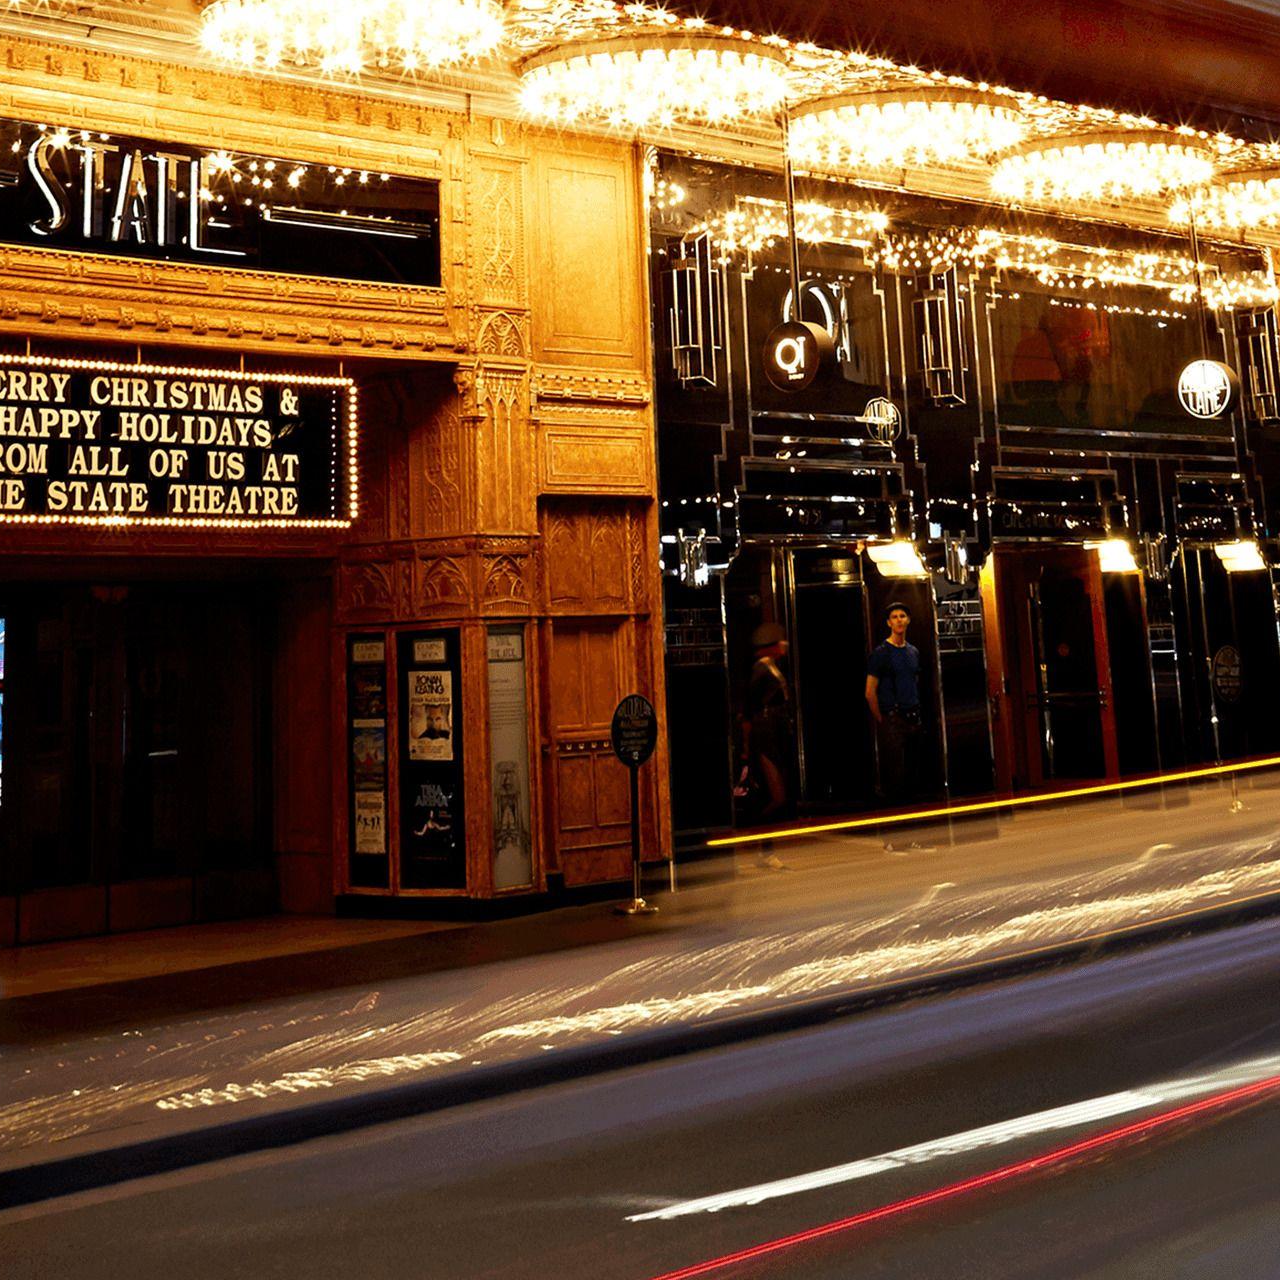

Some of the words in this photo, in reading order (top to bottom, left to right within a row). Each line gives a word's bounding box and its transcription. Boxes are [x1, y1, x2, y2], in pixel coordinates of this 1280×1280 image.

[27, 134, 254, 256] STATE
[90, 376, 264, 414] CHRISTMAS
[280, 388, 299, 416] &
[119, 411, 271, 447] HOLIDAYS
[68, 445, 129, 476] ALL
[149, 448, 189, 478] OF
[207, 451, 246, 480] US
[262, 453, 299, 482] AT
[47, 481, 149, 512] STATE
[169, 484, 299, 516] THEATRE
